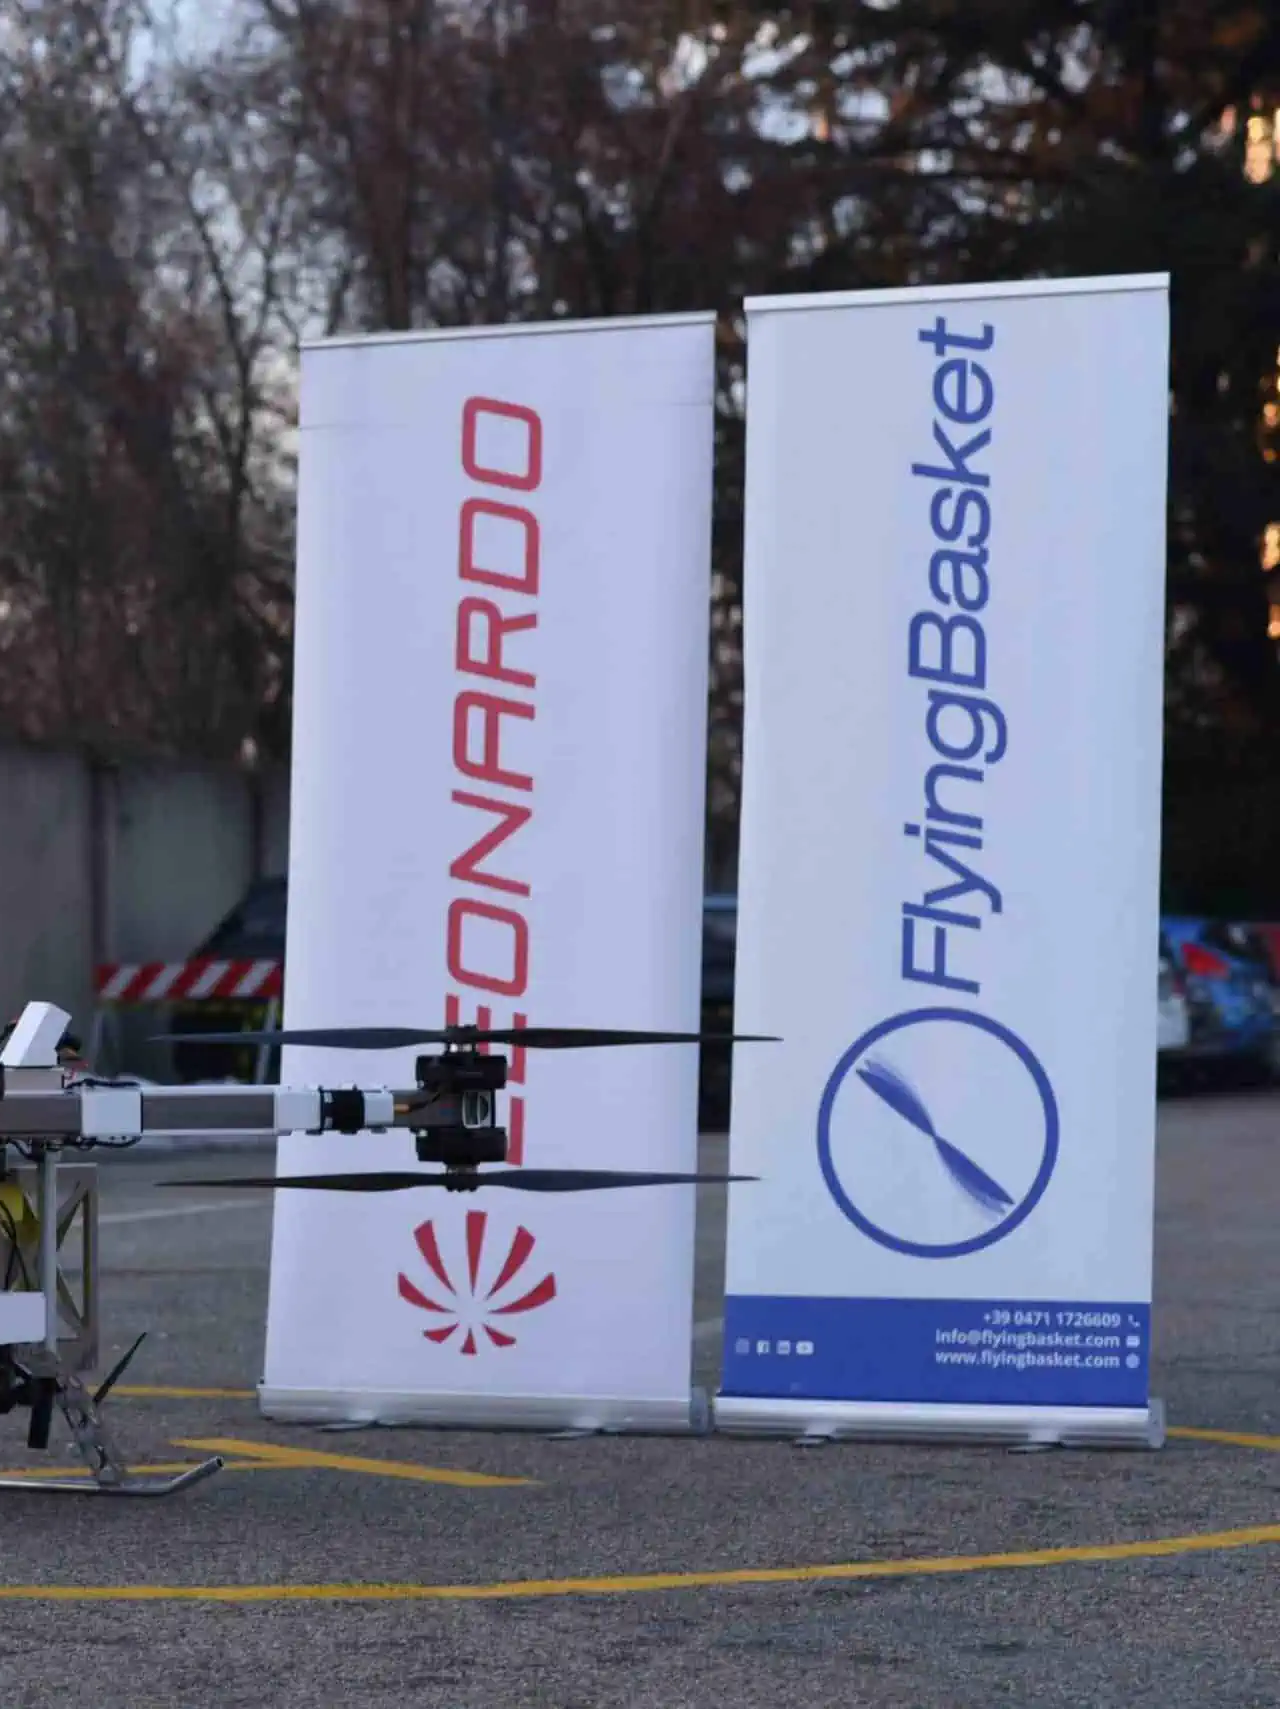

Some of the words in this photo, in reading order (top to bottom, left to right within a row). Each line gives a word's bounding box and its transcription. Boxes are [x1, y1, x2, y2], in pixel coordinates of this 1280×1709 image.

[901, 314, 1006, 994] FlyingBasket
[983, 1309, 1011, 1325] +39
[1014, 1310, 1051, 1326] 0471
[935, 1349, 1121, 1371] www.flyingbasket.com
